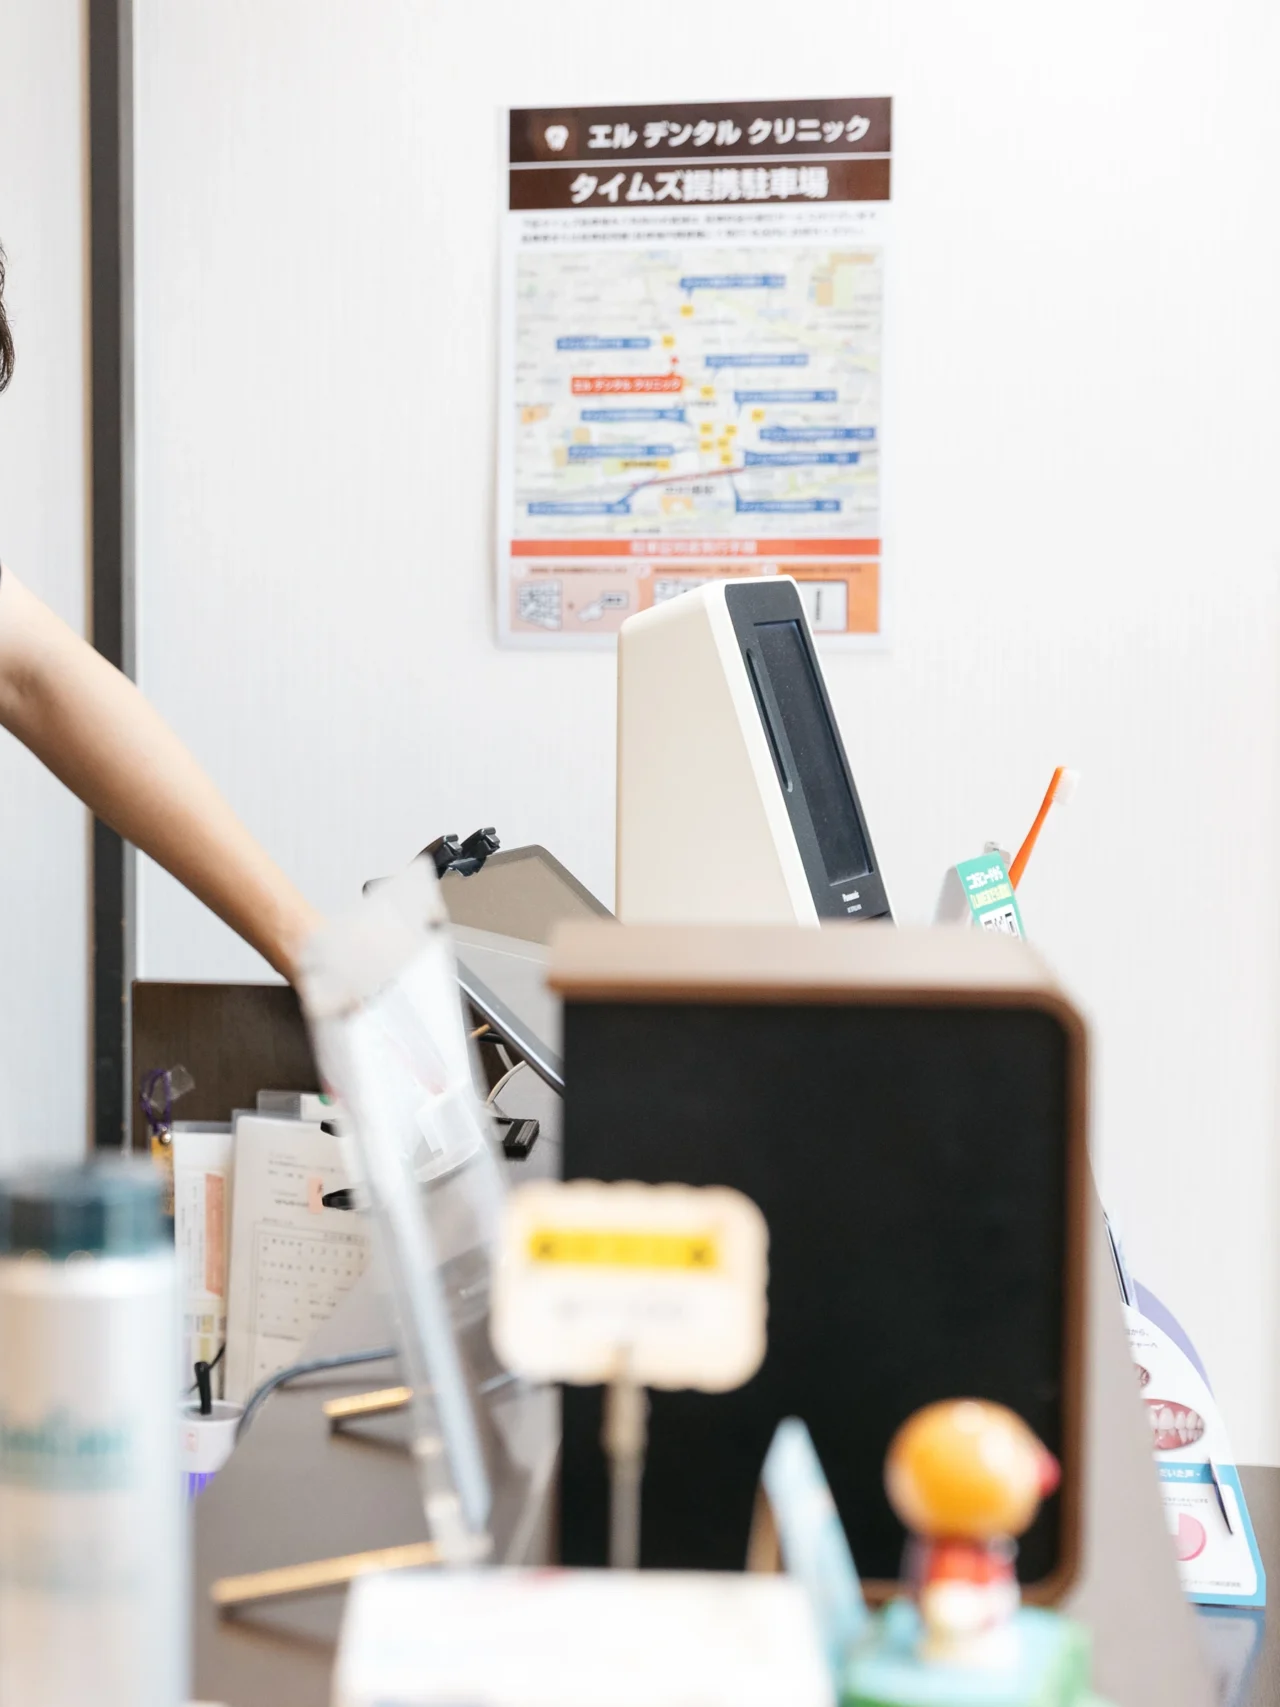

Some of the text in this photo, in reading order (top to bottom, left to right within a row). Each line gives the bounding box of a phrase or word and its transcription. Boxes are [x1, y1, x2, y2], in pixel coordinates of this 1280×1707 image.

[587, 114, 872, 150] エル デンタル クリニック
[569, 166, 829, 204] タイムズ提携駐車場
